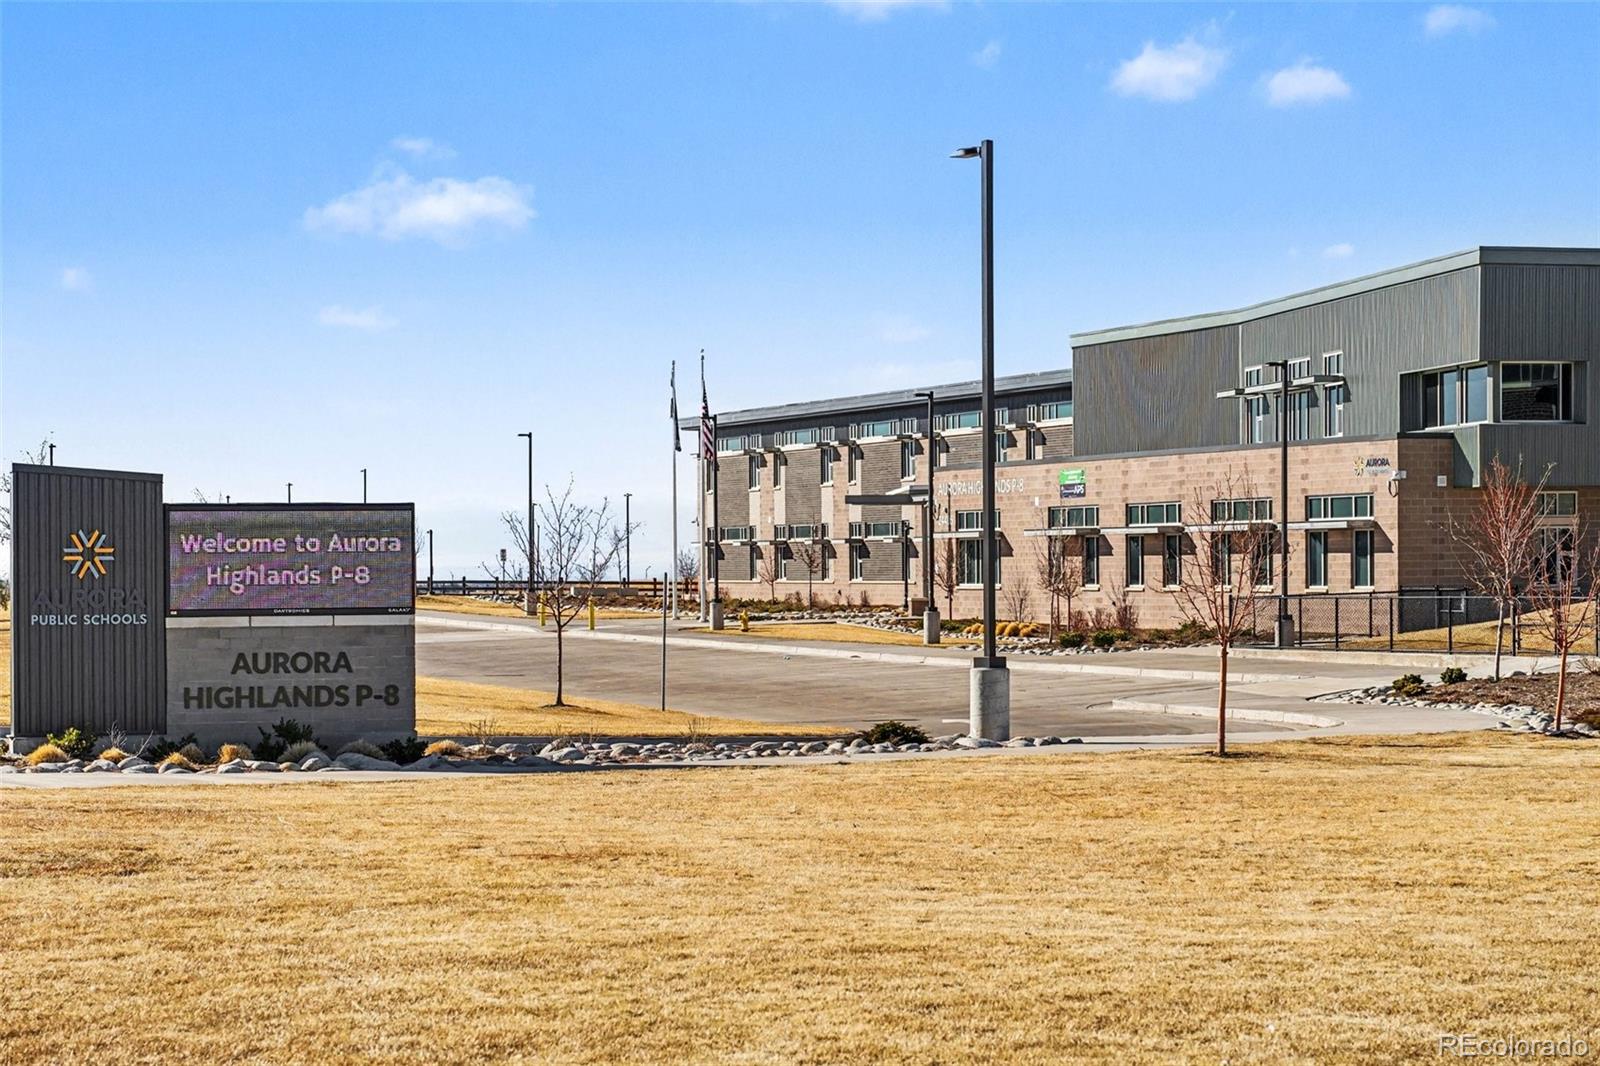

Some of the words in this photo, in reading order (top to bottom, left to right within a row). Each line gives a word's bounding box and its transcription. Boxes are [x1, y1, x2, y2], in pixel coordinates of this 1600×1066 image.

[1366, 458, 1390, 466] AURORA
[938, 482, 967, 496] AURORA
[967, 479, 1010, 494] HIGHNDS
[180, 532, 287, 553] Welcome
[294, 534, 320, 552] to
[327, 533, 401, 552] Aurora
[206, 564, 321, 595] Highlands
[331, 566, 371, 584] P-8
[32, 587, 146, 608] AURORA
[31, 614, 78, 626] PUBLIC
[83, 613, 148, 625] SCHOOLS
[231, 651, 353, 675] AURORA
[183, 684, 349, 710] HIGHLANDS
[355, 684, 400, 707] P-8
